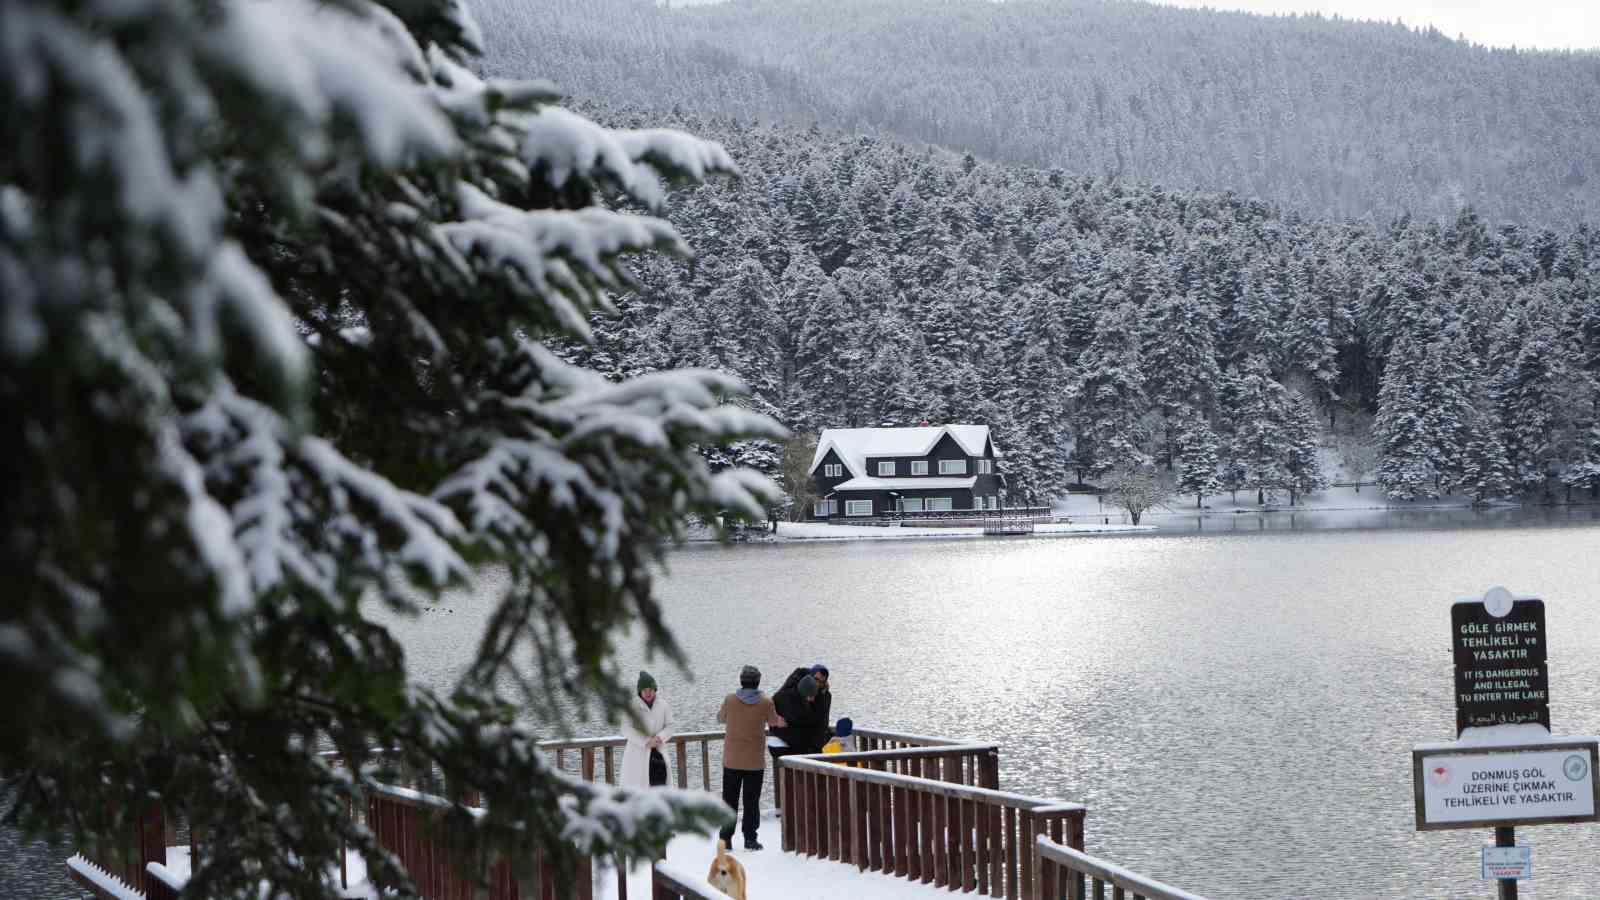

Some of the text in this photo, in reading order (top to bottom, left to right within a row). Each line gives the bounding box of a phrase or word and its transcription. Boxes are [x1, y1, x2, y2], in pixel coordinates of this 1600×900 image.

[1461, 621, 1537, 634] GÖLE GİRMEK
[1462, 635, 1519, 647] TEHLİKELİ
[1473, 649, 1528, 660] YASAKTIR
[1464, 668, 1539, 680] IT IS DANGEROUS
[1474, 680, 1530, 689] AND ILLEGAL
[1460, 690, 1545, 702] TO ENTER THE LAKE
[1471, 767, 1546, 781] DONMUŞ GÖL
[1463, 780, 1556, 794] ÜZERİNE ÇIKMAK
[1443, 794, 1500, 808] TEHLİKELİ
[1503, 795, 1517, 805] VE
